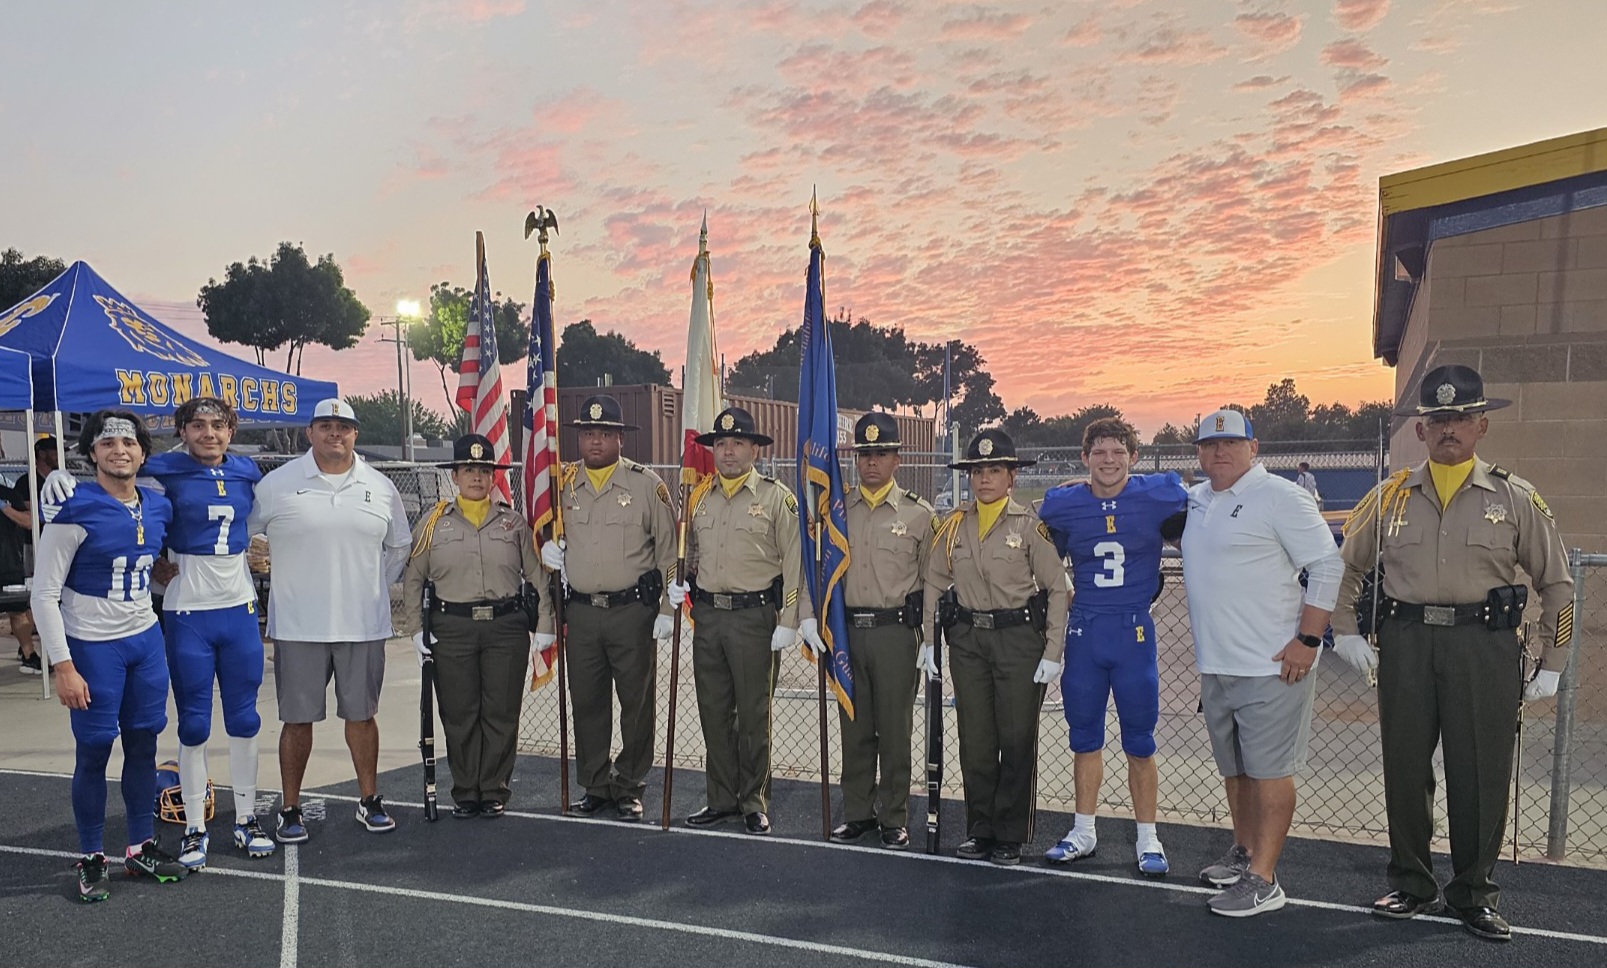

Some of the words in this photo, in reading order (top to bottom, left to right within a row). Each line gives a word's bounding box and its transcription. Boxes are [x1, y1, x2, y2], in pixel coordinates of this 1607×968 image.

[115, 369, 298, 415] MONARCHS
[1215, 416, 1225, 431] E
[365, 491, 371, 502] E
[1230, 505, 1242, 517] E
[208, 505, 235, 555] 7
[1106, 515, 1116, 533] E
[1093, 541, 1126, 588] 3
[108, 555, 153, 601] 10
[1136, 626, 1145, 642] E
